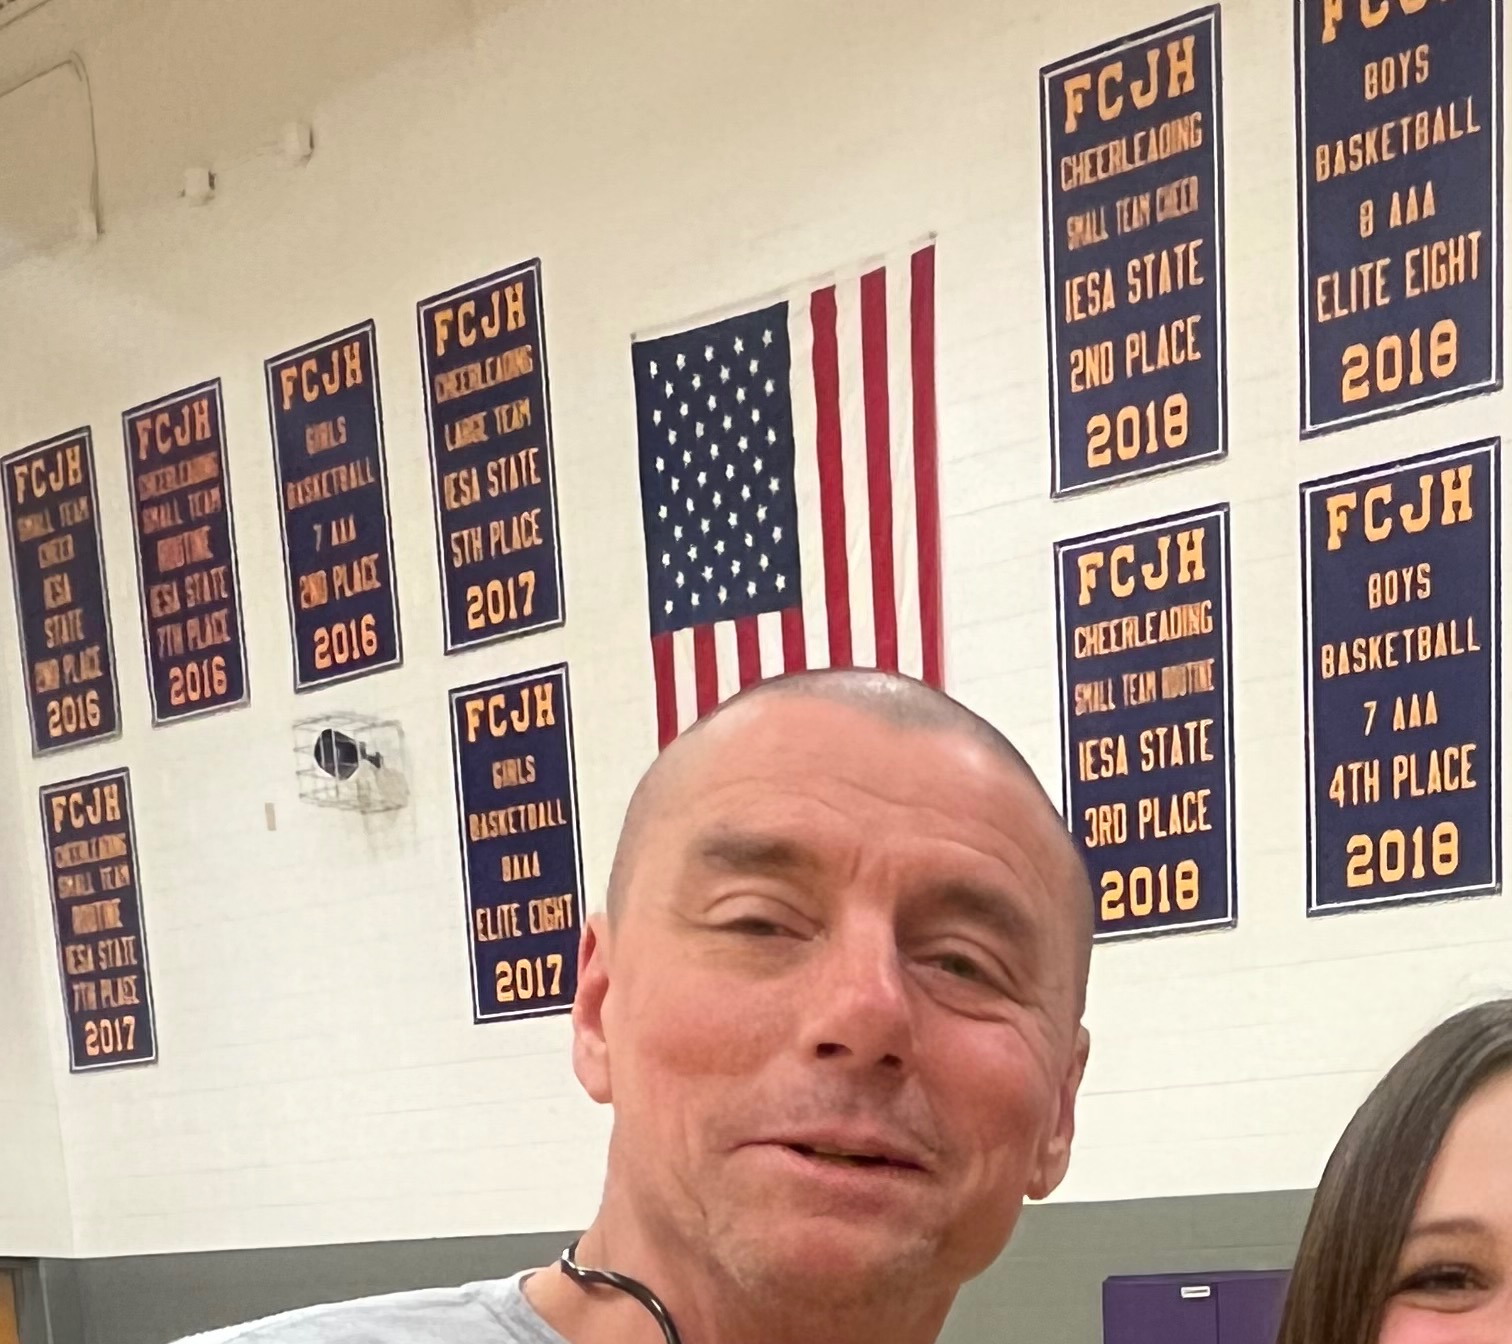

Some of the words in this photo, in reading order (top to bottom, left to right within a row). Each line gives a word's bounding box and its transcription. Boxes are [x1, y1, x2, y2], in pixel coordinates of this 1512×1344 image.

[1064, 35, 1195, 134] FCJH
[1365, 44, 1429, 100] BOYS
[1316, 96, 1481, 182] BASKETBALL
[1389, 181, 1435, 229] AAA
[1064, 268, 1116, 324] IESA
[1127, 239, 1204, 305] STATE
[1317, 258, 1391, 322] ELITE
[1405, 230, 1481, 298] EIGHT
[434, 282, 526, 357] FCJH
[280, 342, 363, 411] FCJH
[1069, 340, 1114, 394] 2ND
[1125, 315, 1201, 380] PLACE
[1342, 318, 1457, 402] 2018
[136, 397, 211, 460] FCJH
[1086, 392, 1188, 468] 2018
[13, 445, 82, 504] FCJH
[487, 447, 542, 498] STATE
[489, 508, 543, 556] PLACE
[1326, 464, 1473, 550] FCJH
[1078, 527, 1205, 606] FCJH
[1368, 563, 1431, 609] BOYS
[465, 569, 536, 631] 2017
[1074, 600, 1213, 659] CHEERLEADING
[314, 614, 378, 670] 2016
[1322, 616, 1481, 679] BASKETBALL
[169, 656, 227, 707] 2016
[47, 689, 100, 738] 2016
[465, 682, 556, 743] FCJH
[1364, 700, 1377, 736] 7
[1393, 690, 1438, 732] AAA
[1079, 734, 1129, 781] IESA
[1140, 719, 1214, 773] STATE
[1329, 759, 1379, 808] 4TH
[1393, 743, 1477, 800] PLACE
[51, 783, 120, 833] FCJH
[1085, 802, 1127, 848] 3RD
[1139, 788, 1212, 840] PLACE
[1346, 821, 1459, 888] 2018
[1100, 859, 1199, 920] 2018
[495, 954, 563, 1002] 2017
[84, 1015, 135, 1056] 2017
